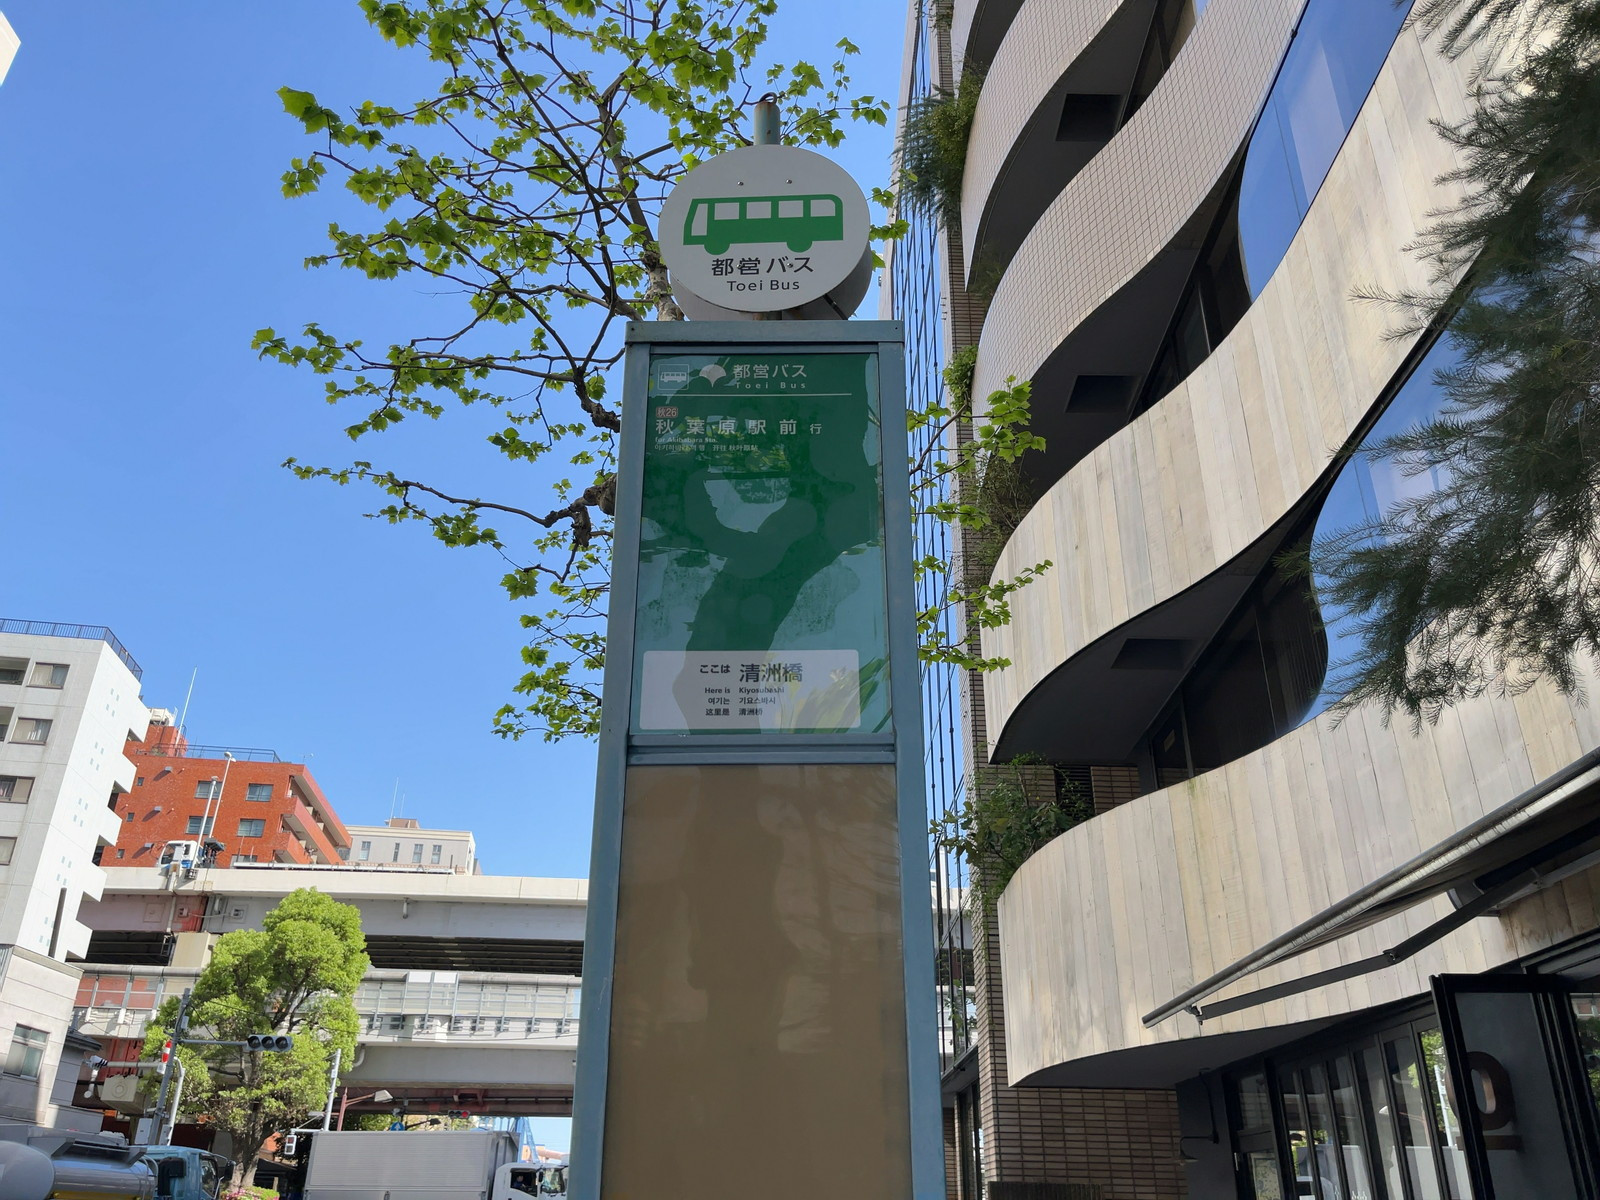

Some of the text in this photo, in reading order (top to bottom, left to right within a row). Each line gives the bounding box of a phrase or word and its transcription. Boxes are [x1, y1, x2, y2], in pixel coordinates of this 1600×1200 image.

[711, 256, 814, 276] 都営バス
[727, 279, 800, 292] Toei Bus
[732, 364, 807, 379] 都営バス
[735, 381, 807, 389] Toei Bus
[656, 407, 678, 417] 秋26
[699, 662, 803, 683] ここは 清洲橋
[724, 686, 731, 694] is
[738, 686, 785, 695] Kiyosubashi
[707, 697, 776, 705] 여기는 기요스바시
